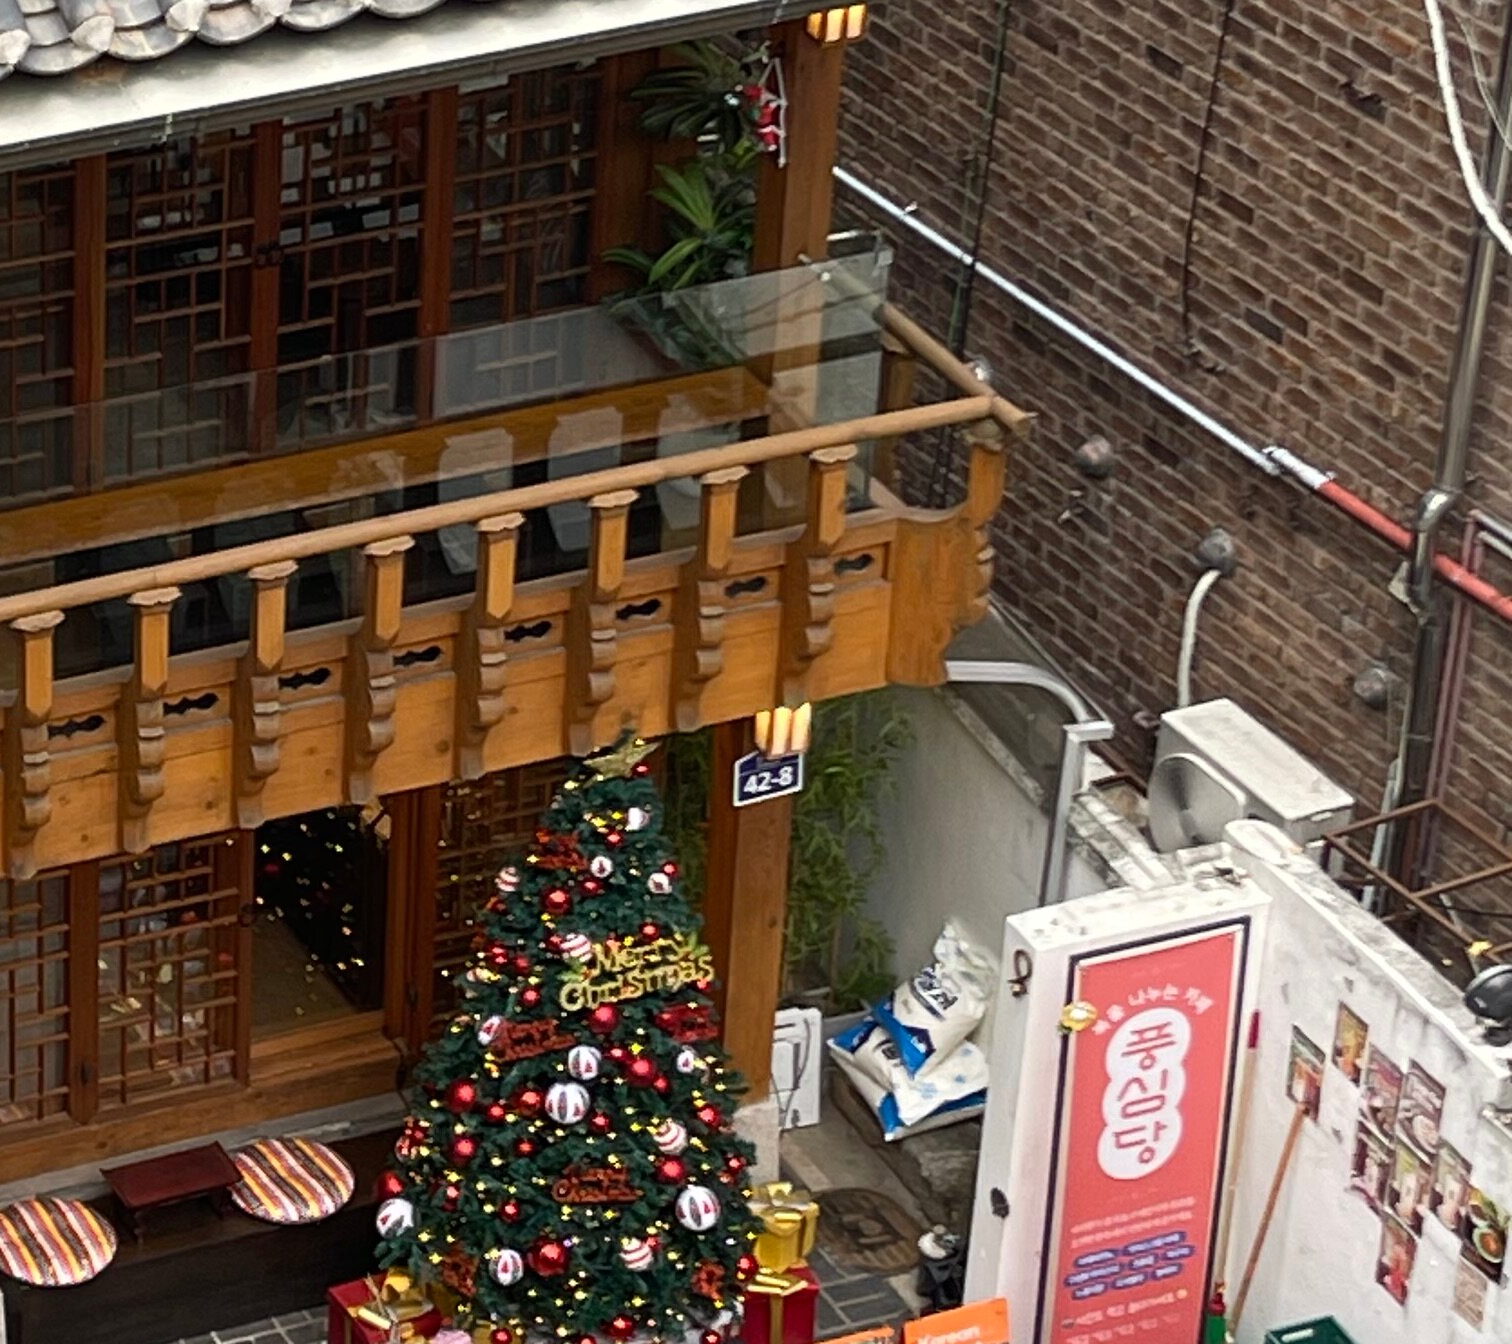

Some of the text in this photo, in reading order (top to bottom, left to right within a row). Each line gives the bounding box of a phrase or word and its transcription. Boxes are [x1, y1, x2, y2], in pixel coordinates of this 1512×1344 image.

[743, 765, 794, 794] 42-8
[591, 933, 692, 977] Merry
[559, 955, 714, 1011] Christmas
[1112, 1021, 1176, 1164] 풍심당
